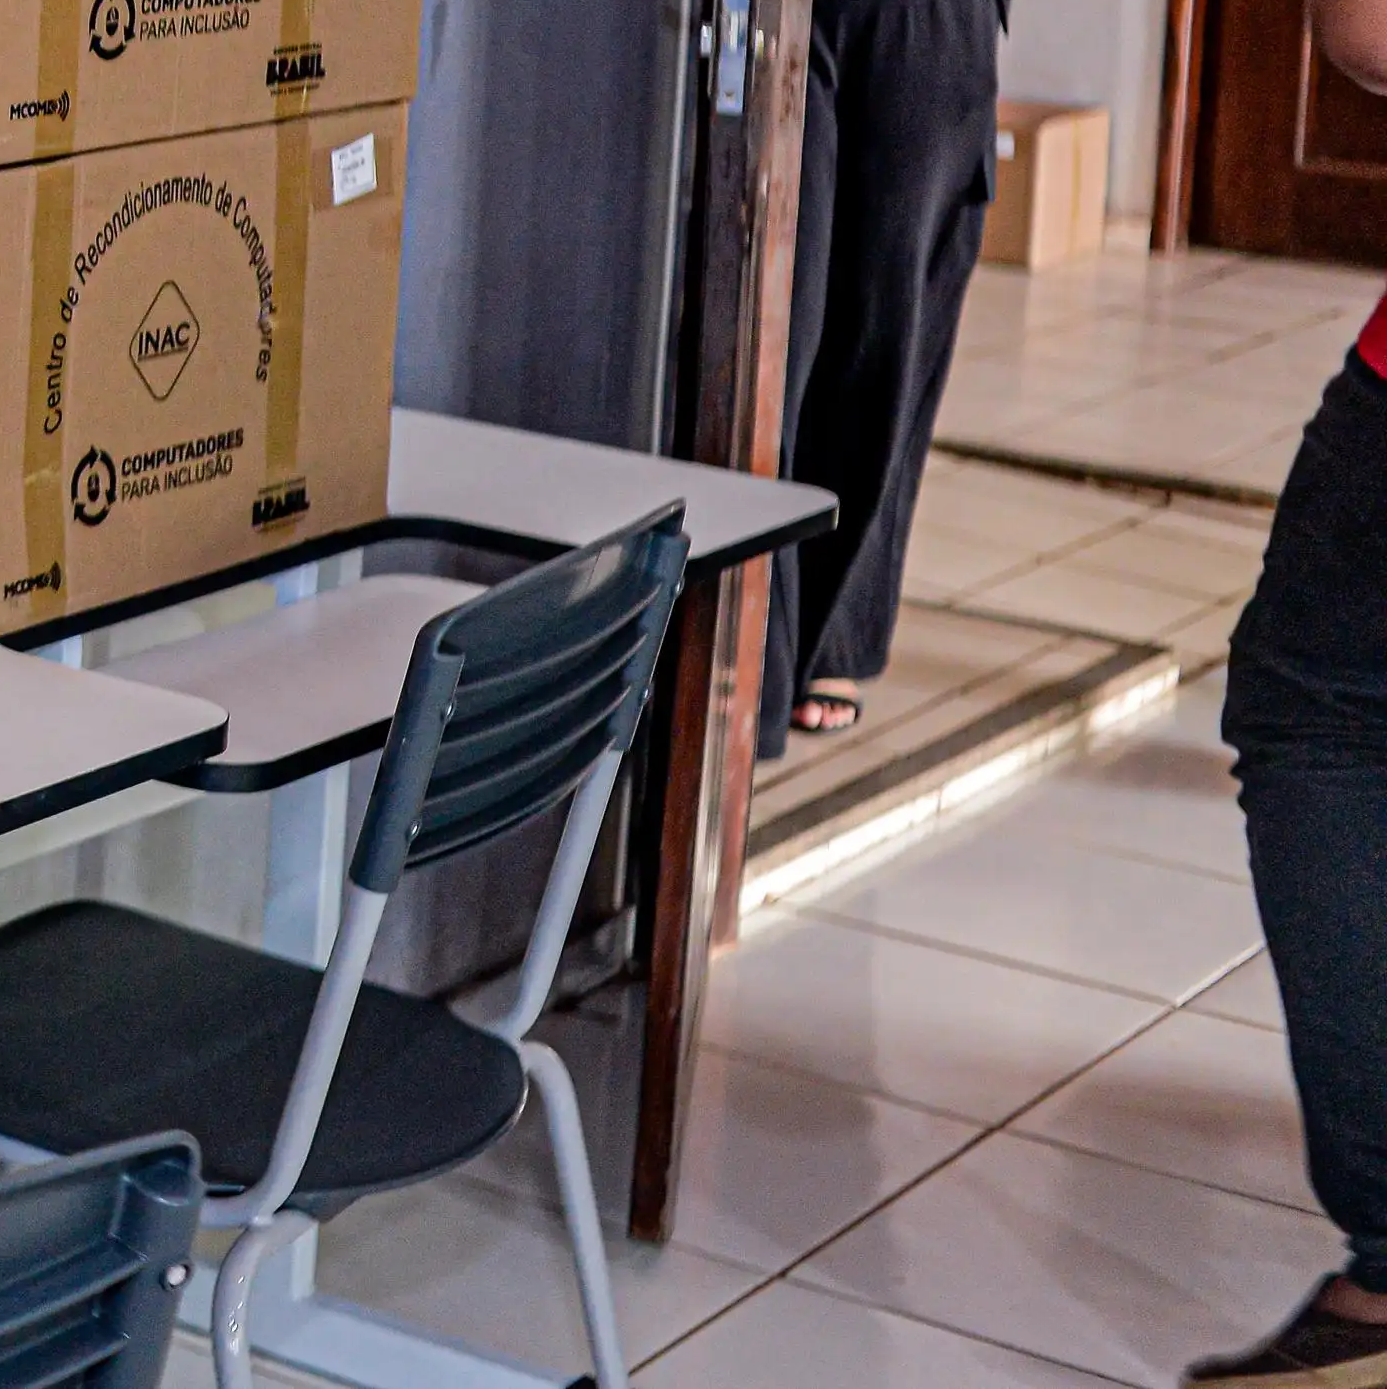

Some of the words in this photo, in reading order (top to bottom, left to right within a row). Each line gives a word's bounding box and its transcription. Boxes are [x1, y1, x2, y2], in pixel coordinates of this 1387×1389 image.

[139, 17, 177, 42] PARA
[180, 5, 250, 37] INCLUSÃO
[43, 333, 66, 435] Centro
[60, 286, 79, 324] de
[73, 172, 213, 285] Recondicionamento
[215, 181, 232, 218] de
[138, 321, 190, 355] INAC
[121, 428, 244, 477] COMPUTADORES
[121, 476, 160, 503] PARA
[164, 454, 233, 493] INCLUSÃO
